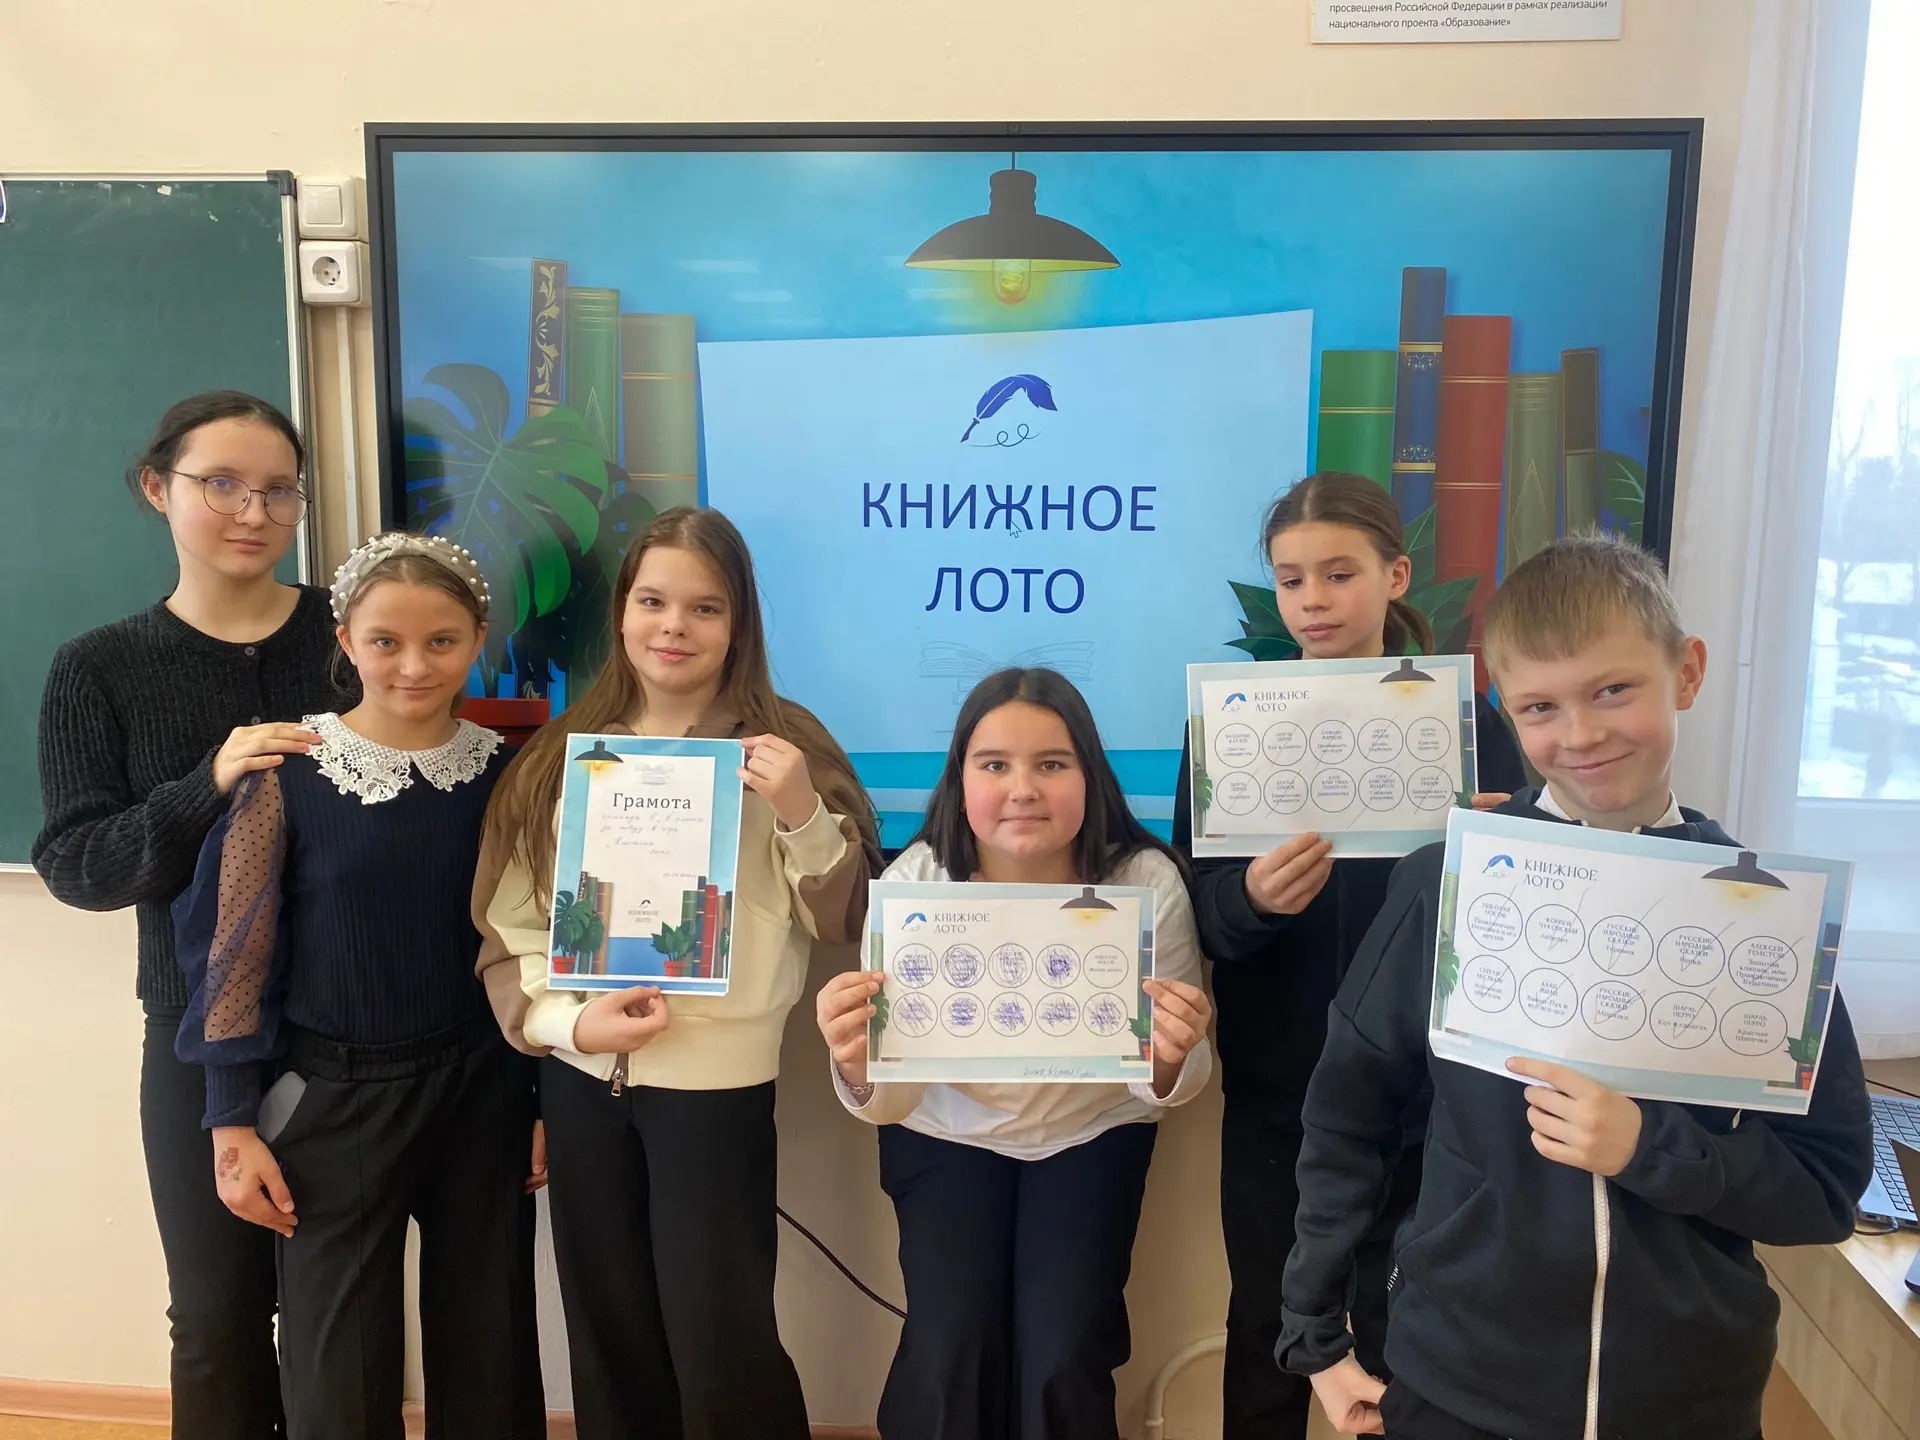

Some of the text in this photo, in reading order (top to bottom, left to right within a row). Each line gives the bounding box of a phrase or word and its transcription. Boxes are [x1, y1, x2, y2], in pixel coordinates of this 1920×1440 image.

[1329, 3, 1392, 12] просвещения
[1395, 2, 1449, 12] Российской
[1451, 1, 1505, 12] Федерации
[1515, 2, 1548, 12] рамках
[1550, 0, 1607, 11] реализации
[1329, 17, 1511, 29] национального проекта «Образование»
[863, 482, 1157, 531] КНИЖНОЕ
[925, 566, 1084, 614] ЛОТО
[1254, 690, 1310, 701] КНИЖНОЕ
[1255, 702, 1287, 713] ЛОТО
[612, 792, 691, 811] Грамота
[1524, 858, 1598, 882] КНИЖНОЕ
[1523, 873, 1565, 891] ЛОТО
[934, 912, 990, 923] КНИЖНОЕ
[934, 924, 967, 934] ЛОТО
[1679, 934, 1712, 944] РУССКИЕ
